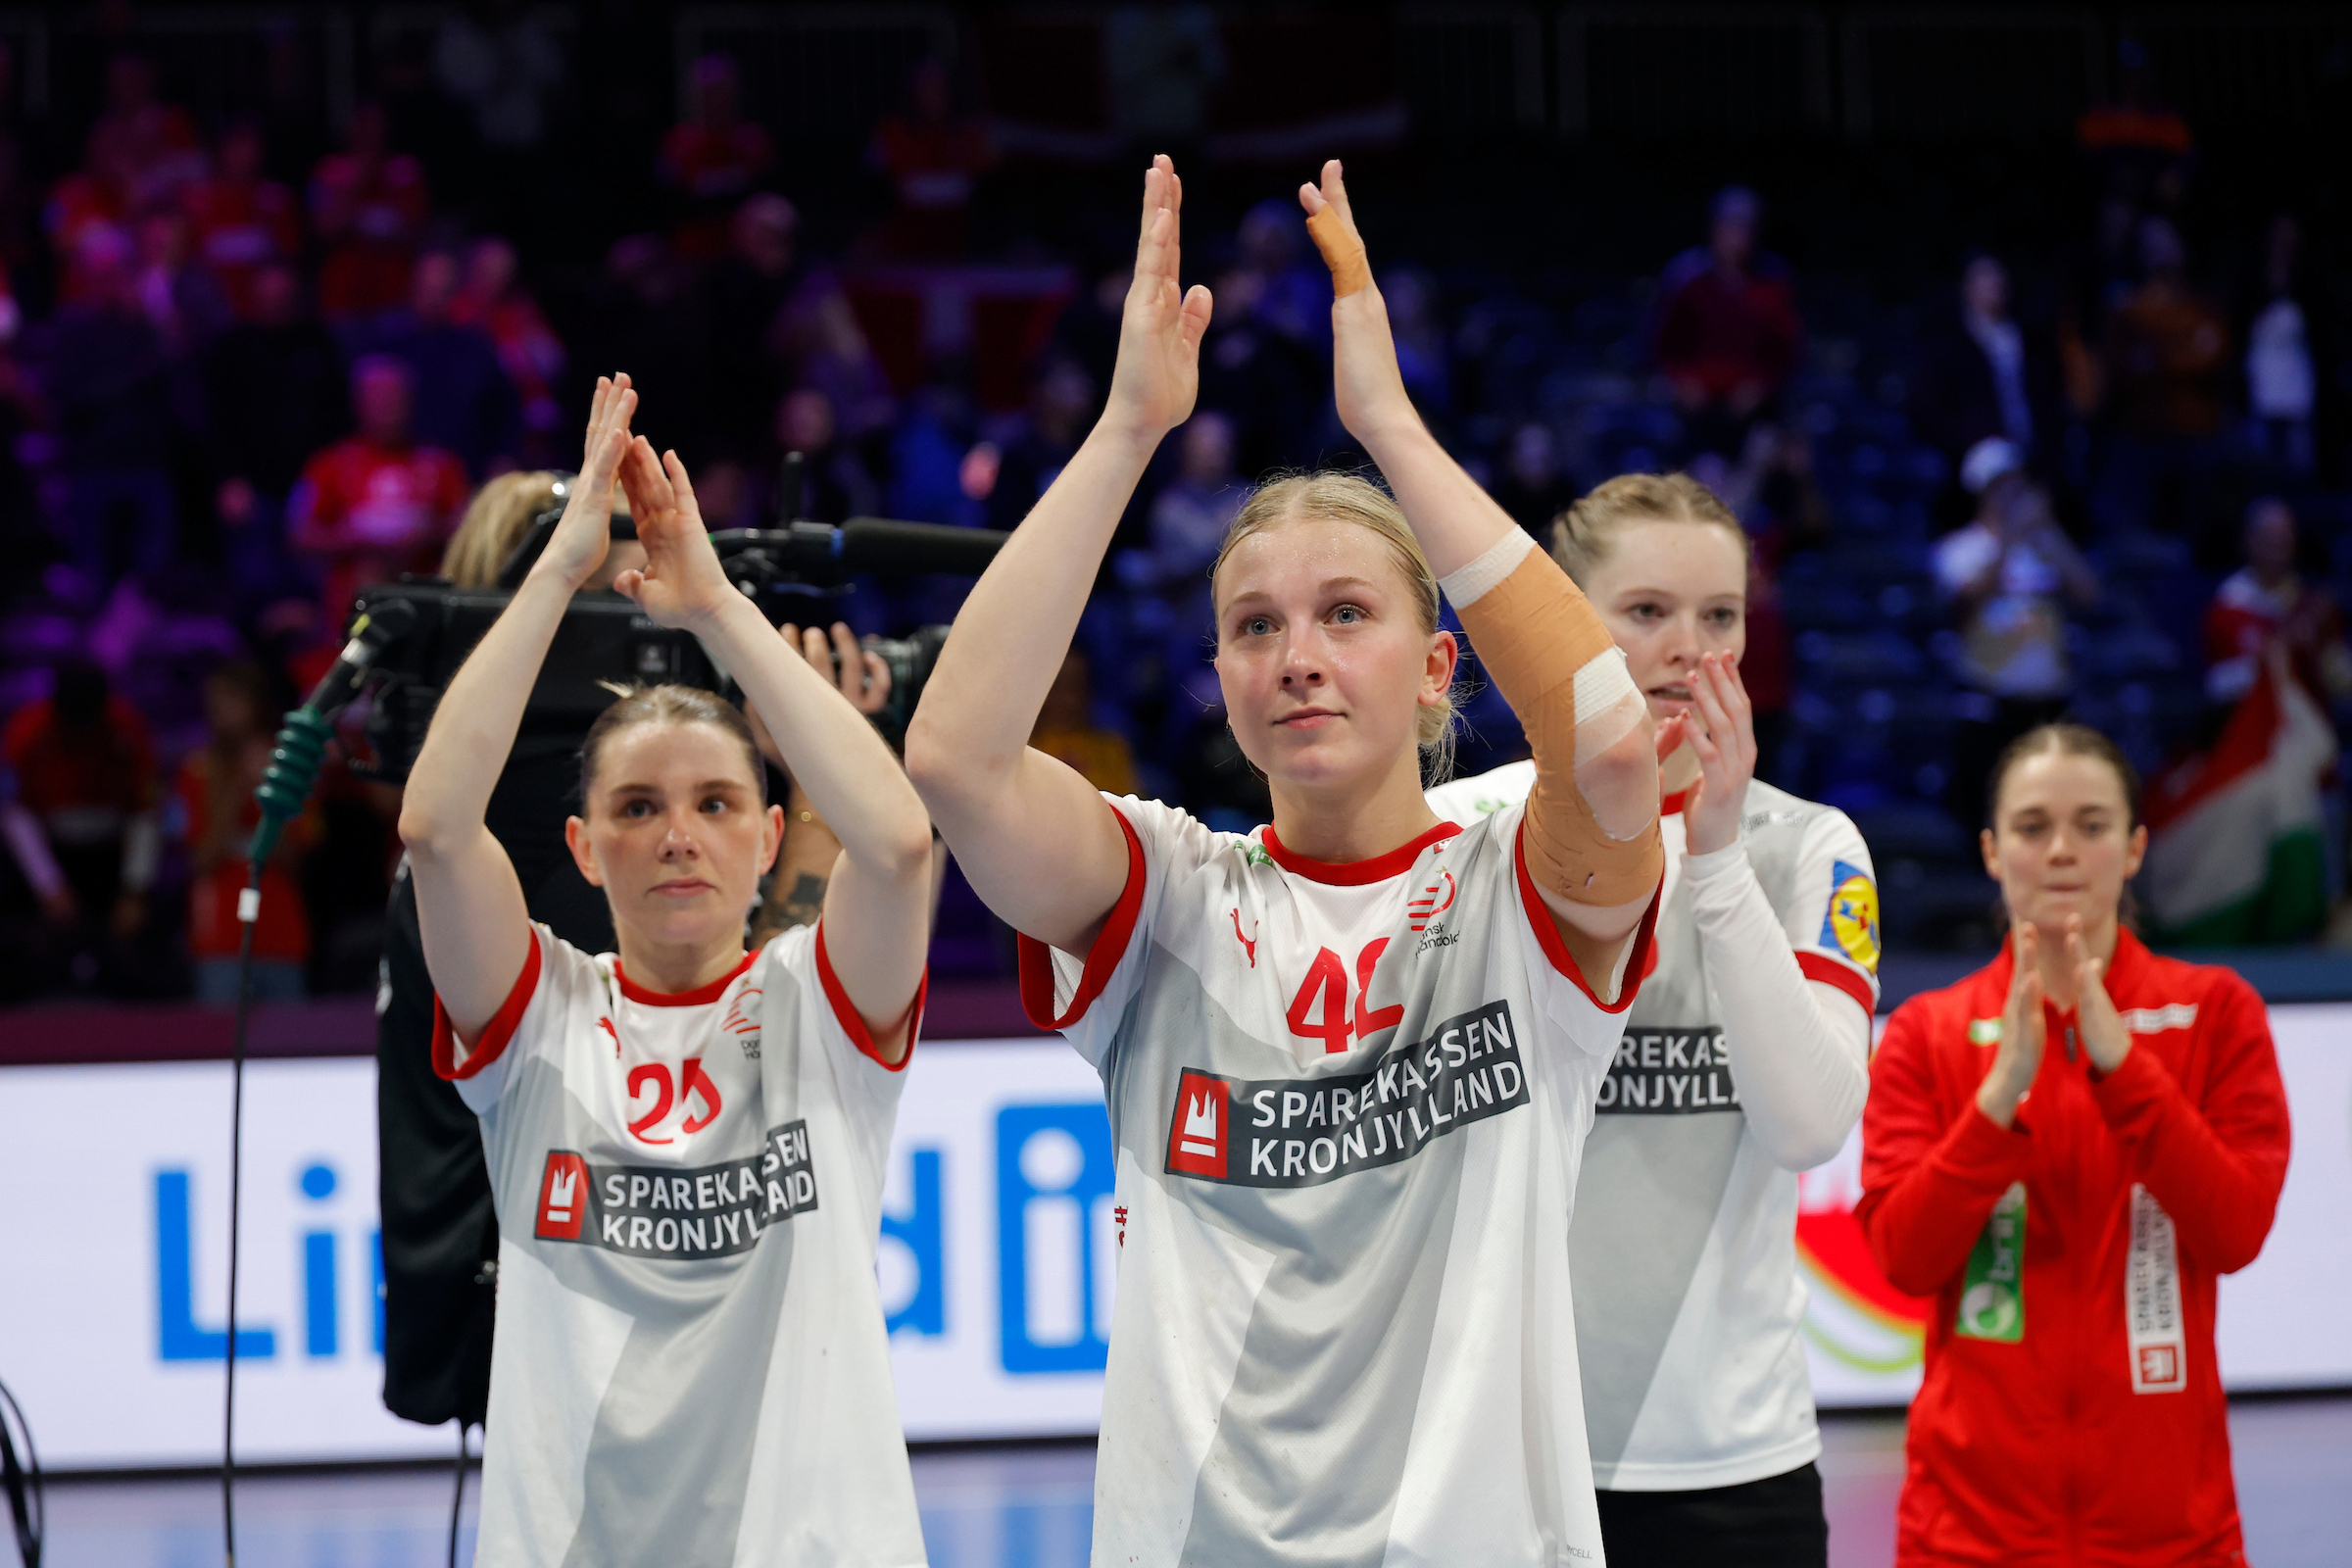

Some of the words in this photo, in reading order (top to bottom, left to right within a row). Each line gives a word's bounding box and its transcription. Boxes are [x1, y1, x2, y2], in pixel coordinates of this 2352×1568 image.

[1251, 1011, 1512, 1128] SPAREKASSEN
[1597, 1072, 1740, 1107] ONJYLL
[1250, 1060, 1521, 1176] KRONJYLLAND
[602, 1170, 814, 1251] KRONJYLAD
[603, 1128, 808, 1211] SPAREKASEN
